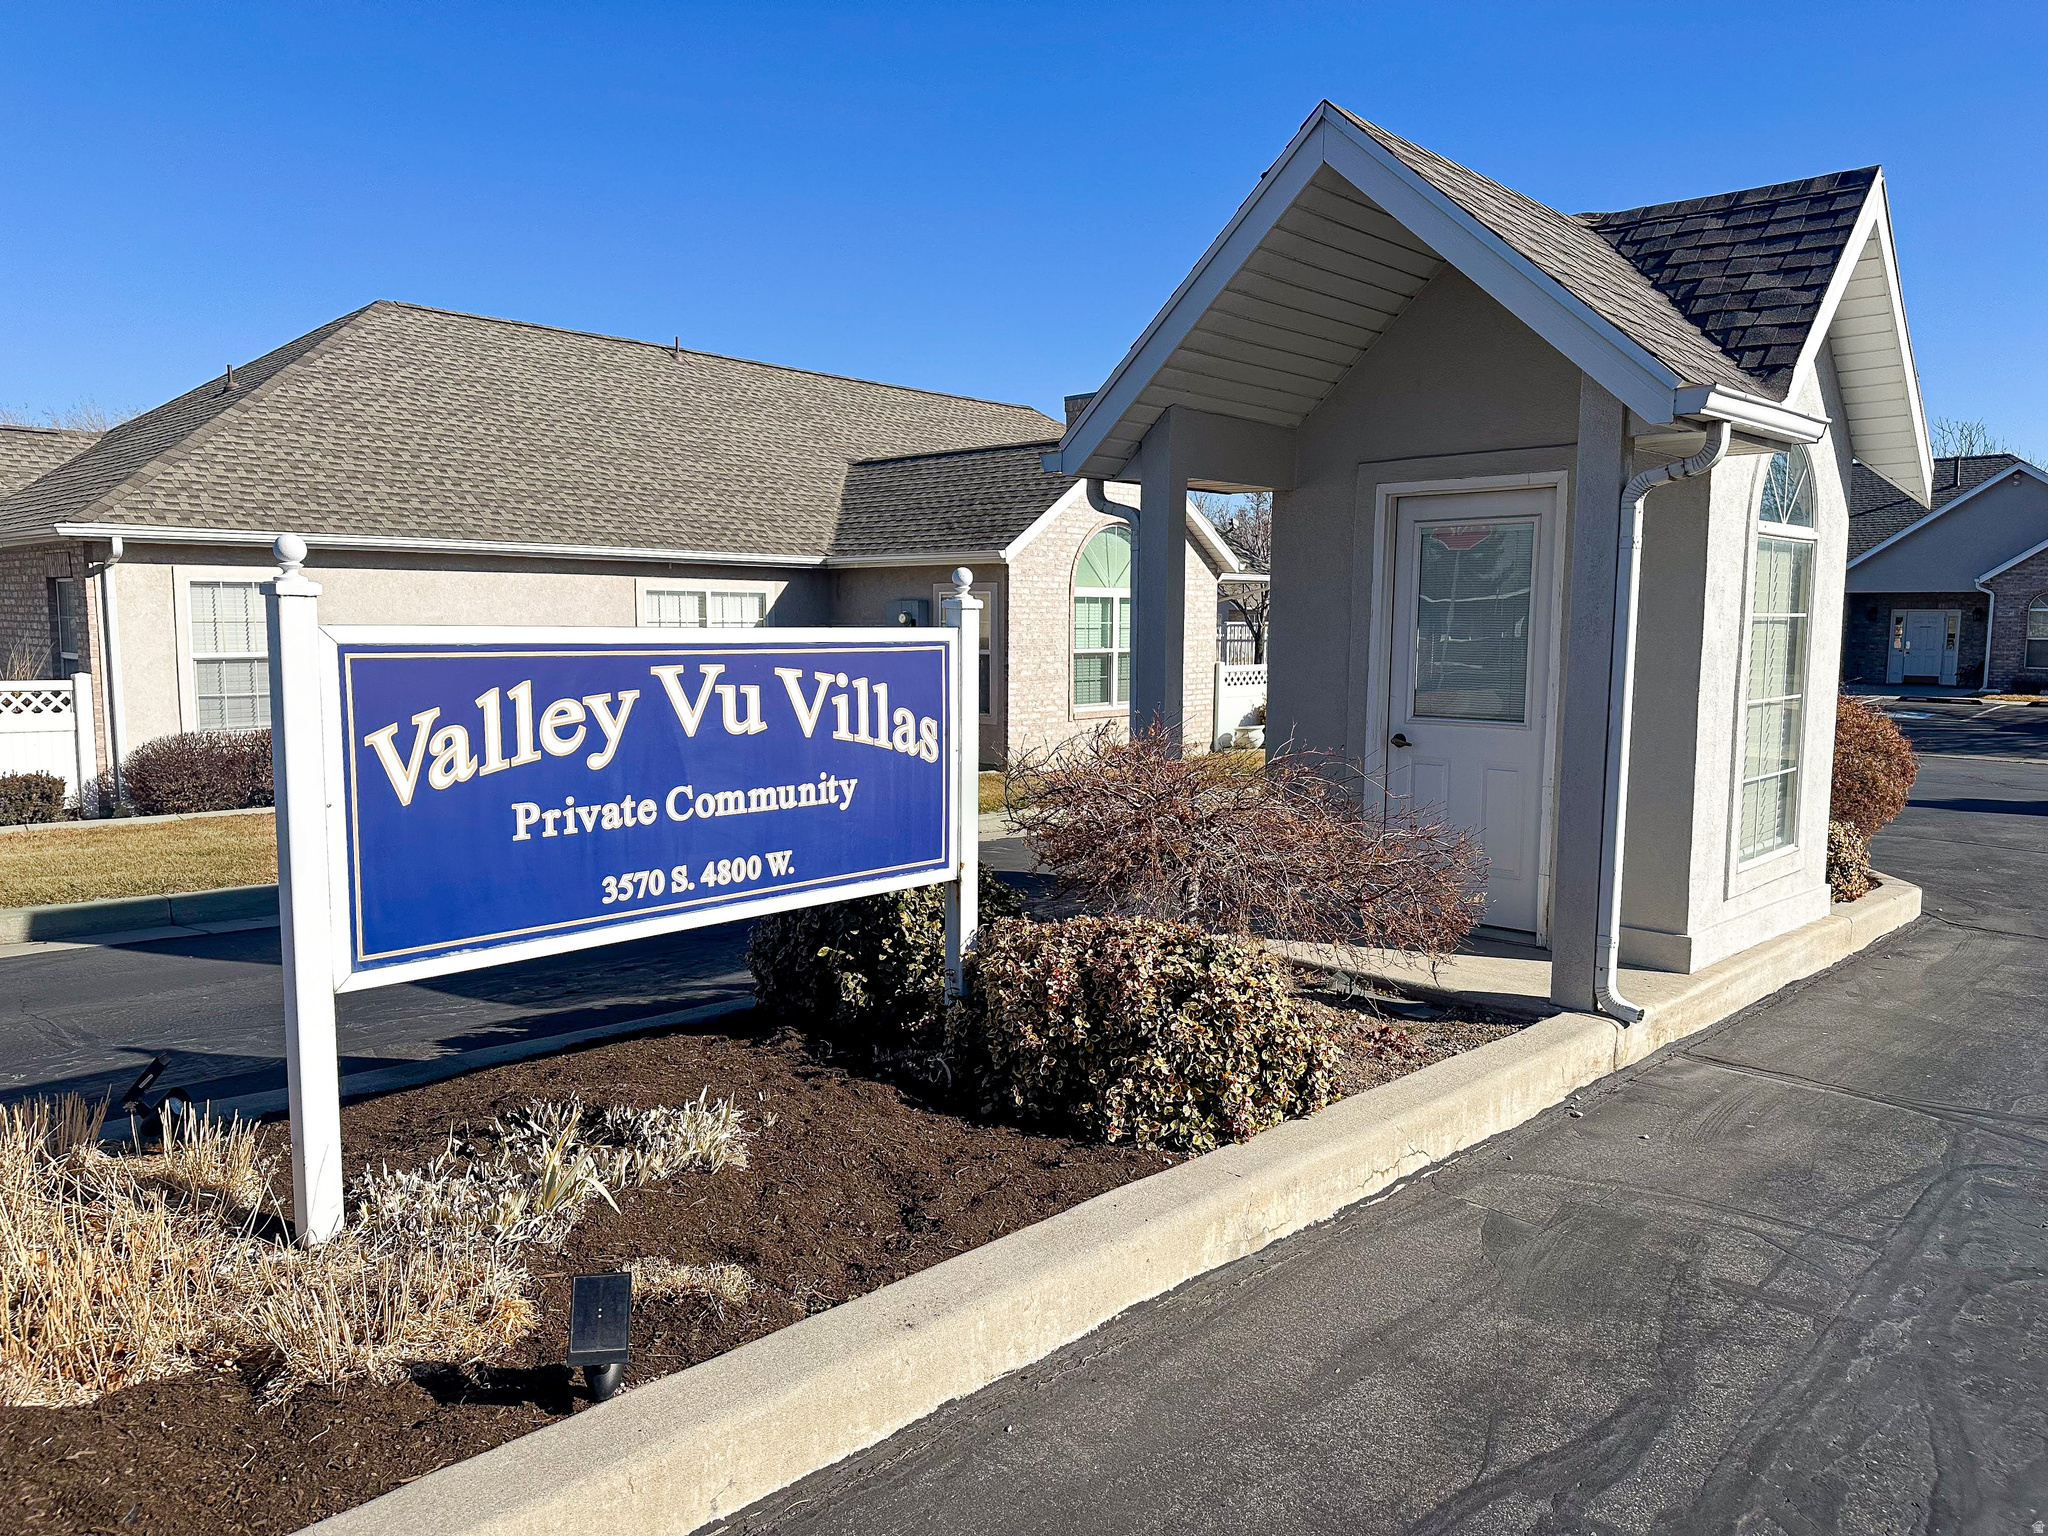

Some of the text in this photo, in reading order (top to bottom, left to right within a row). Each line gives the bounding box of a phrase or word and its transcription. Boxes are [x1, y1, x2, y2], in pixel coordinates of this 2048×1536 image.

[363, 663, 940, 808] Valley Vu Villas
[511, 771, 859, 842] Private Community
[601, 849, 795, 905] 3570 S. 4800 W.
